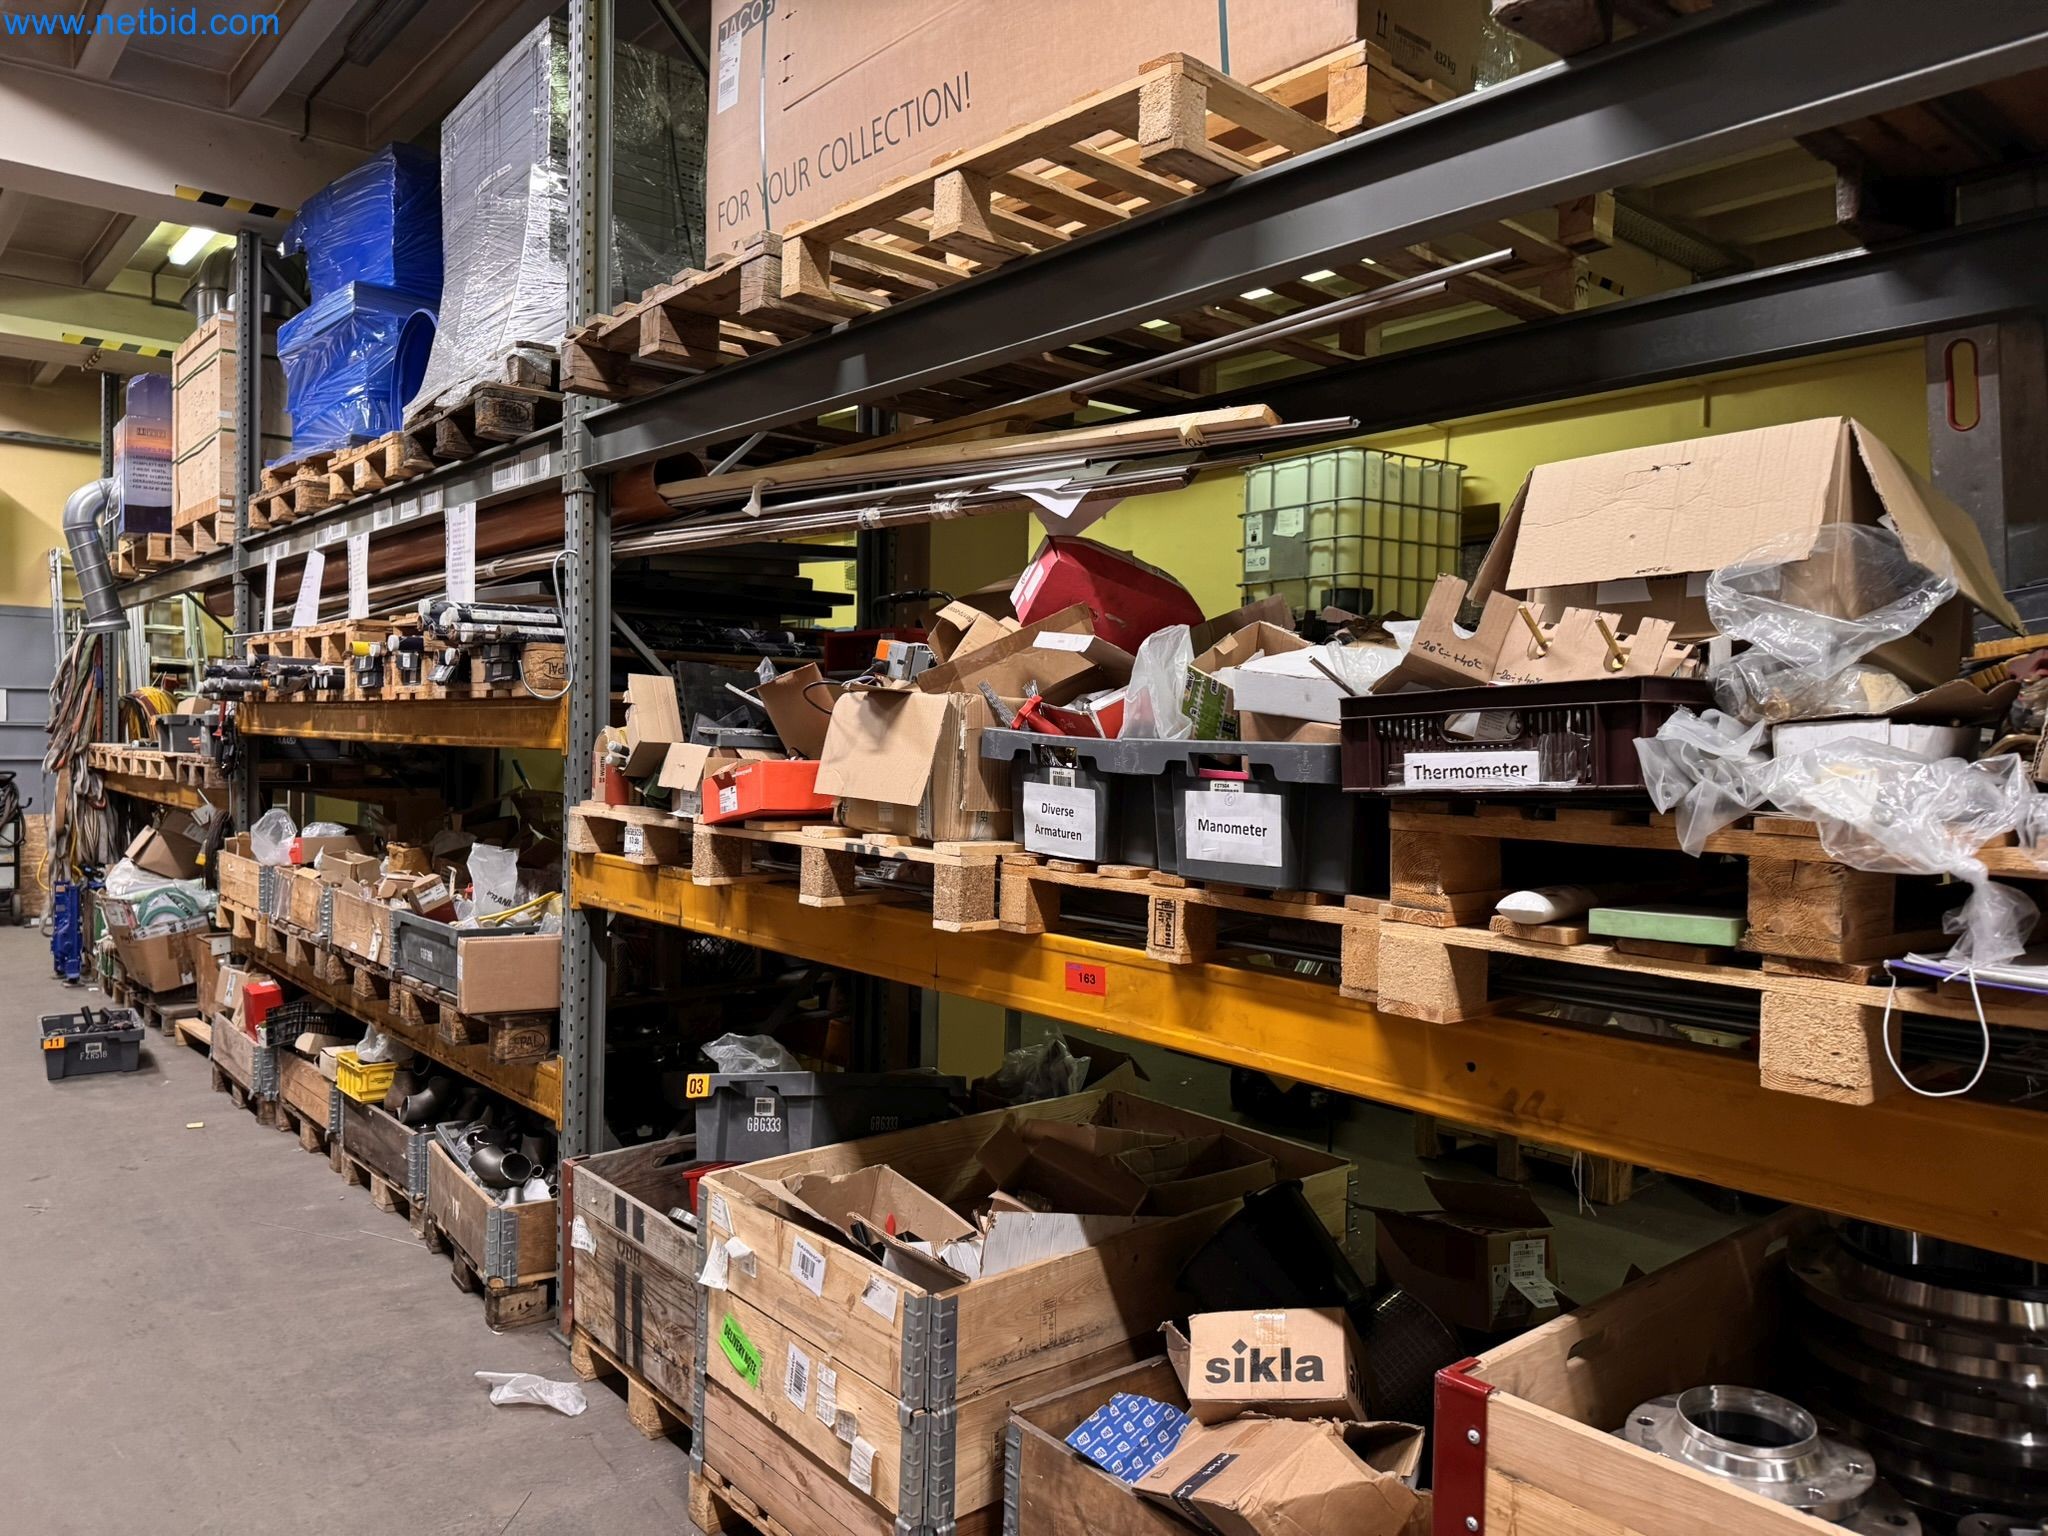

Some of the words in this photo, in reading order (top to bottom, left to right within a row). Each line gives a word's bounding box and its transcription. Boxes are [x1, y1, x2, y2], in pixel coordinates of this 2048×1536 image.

[717, 189, 751, 232] FOR
[757, 156, 810, 210] YOUR
[818, 71, 971, 179] COLLECTION!
[1413, 762, 1528, 780] Thermometer
[1041, 802, 1075, 818] Diverse
[1034, 823, 1082, 841] Armaturen
[1198, 818, 1267, 837] Manometer
[1079, 972, 1096, 984] 163
[48, 1038, 60, 1047] 11
[689, 1078, 704, 1094] 03
[747, 1117, 782, 1132] GBG333
[723, 1323, 746, 1359] DELIVERY
[743, 1351, 757, 1376] NOTE
[1205, 1339, 1325, 1384] sikla
